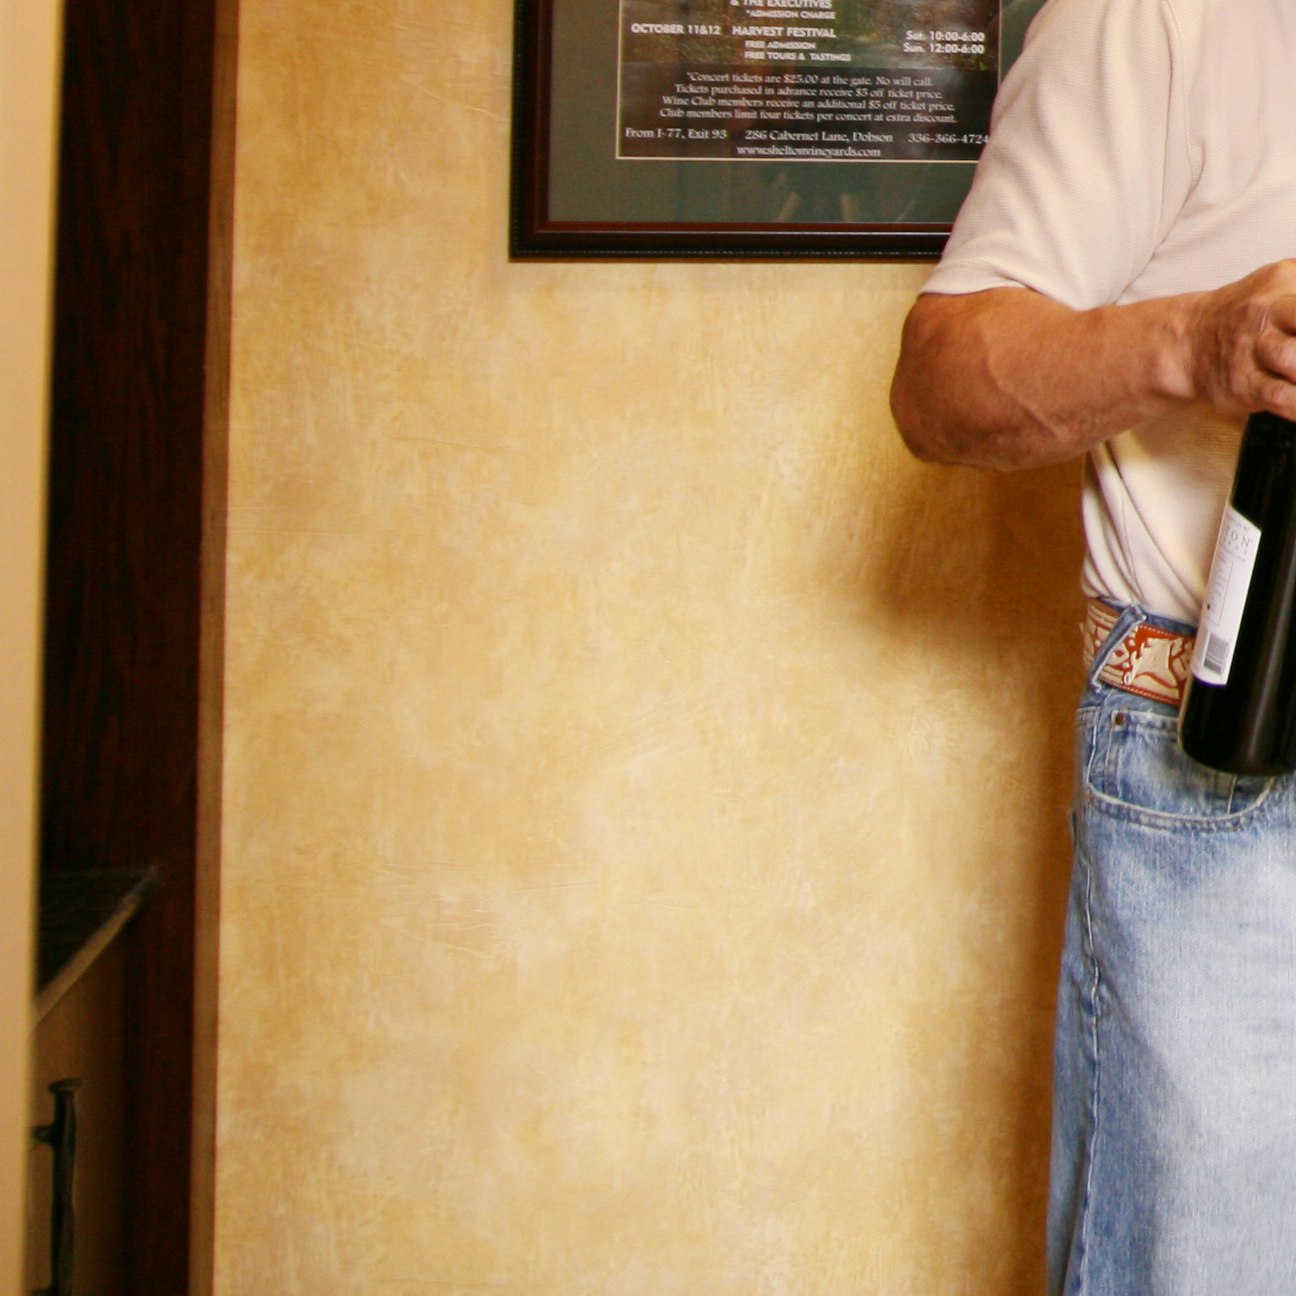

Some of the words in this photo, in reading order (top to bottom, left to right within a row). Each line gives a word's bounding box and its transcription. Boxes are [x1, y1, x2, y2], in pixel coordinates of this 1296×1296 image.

[631, 23, 684, 35] OCTOBER
[687, 24, 722, 36] 11&12
[732, 25, 784, 37] HARVEST
[787, 27, 837, 39] FESTIVAL
[929, 31, 985, 43] 10:00-6:00
[929, 42, 985, 54] 12:00-6:00
[732, 72, 763, 83] tickets
[765, 75, 781, 83] are
[820, 76, 831, 85] at
[832, 75, 848, 85] the
[875, 76, 891, 86] No
[893, 77, 912, 86] will
[674, 83, 709, 94] Tickets
[711, 83, 762, 97] purchased
[764, 85, 775, 95] in
[777, 86, 817, 96] advance
[819, 89, 853, 98] receive
[888, 89, 914, 99] ticket
[662, 96, 689, 106] Wine
[691, 96, 716, 106] Club
[718, 97, 763, 108] members
[900, 101, 927, 111] ticket
[659, 108, 685, 118] Club
[687, 109, 732, 119] members
[734, 109, 758, 119] limit
[760, 110, 781, 120] four
[783, 110, 815, 121] tickets
[817, 113, 833, 122] per
[835, 112, 872, 122] concert
[873, 113, 884, 122] at
[886, 113, 911, 123] extra
[625, 127, 654, 138] From
[688, 128, 710, 139] Exit
[712, 129, 728, 139] 93
[745, 129, 767, 141] 286
[769, 130, 819, 142] Cabernet
[852, 132, 893, 143] Dobson
